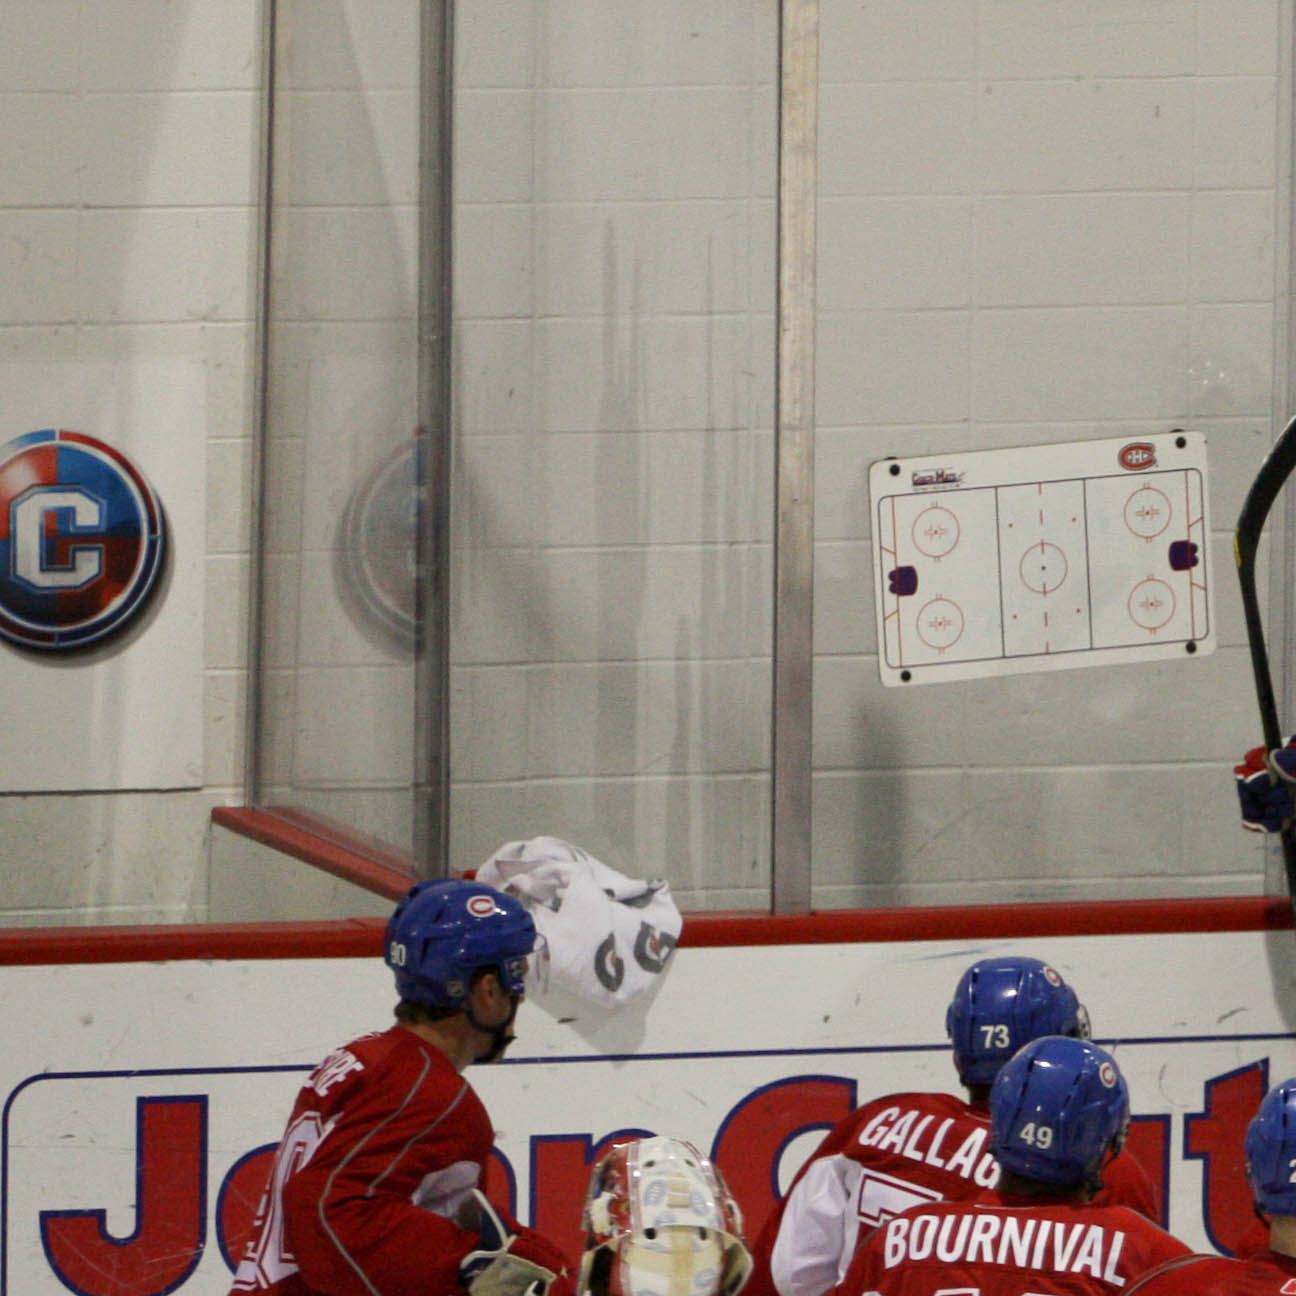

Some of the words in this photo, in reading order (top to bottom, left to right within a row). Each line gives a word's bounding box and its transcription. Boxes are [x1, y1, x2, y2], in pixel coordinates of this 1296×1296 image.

[980, 1024, 1011, 1049] 73
[1019, 1121, 1054, 1150] 49
[884, 1212, 1127, 1288] BOURNIVAL
